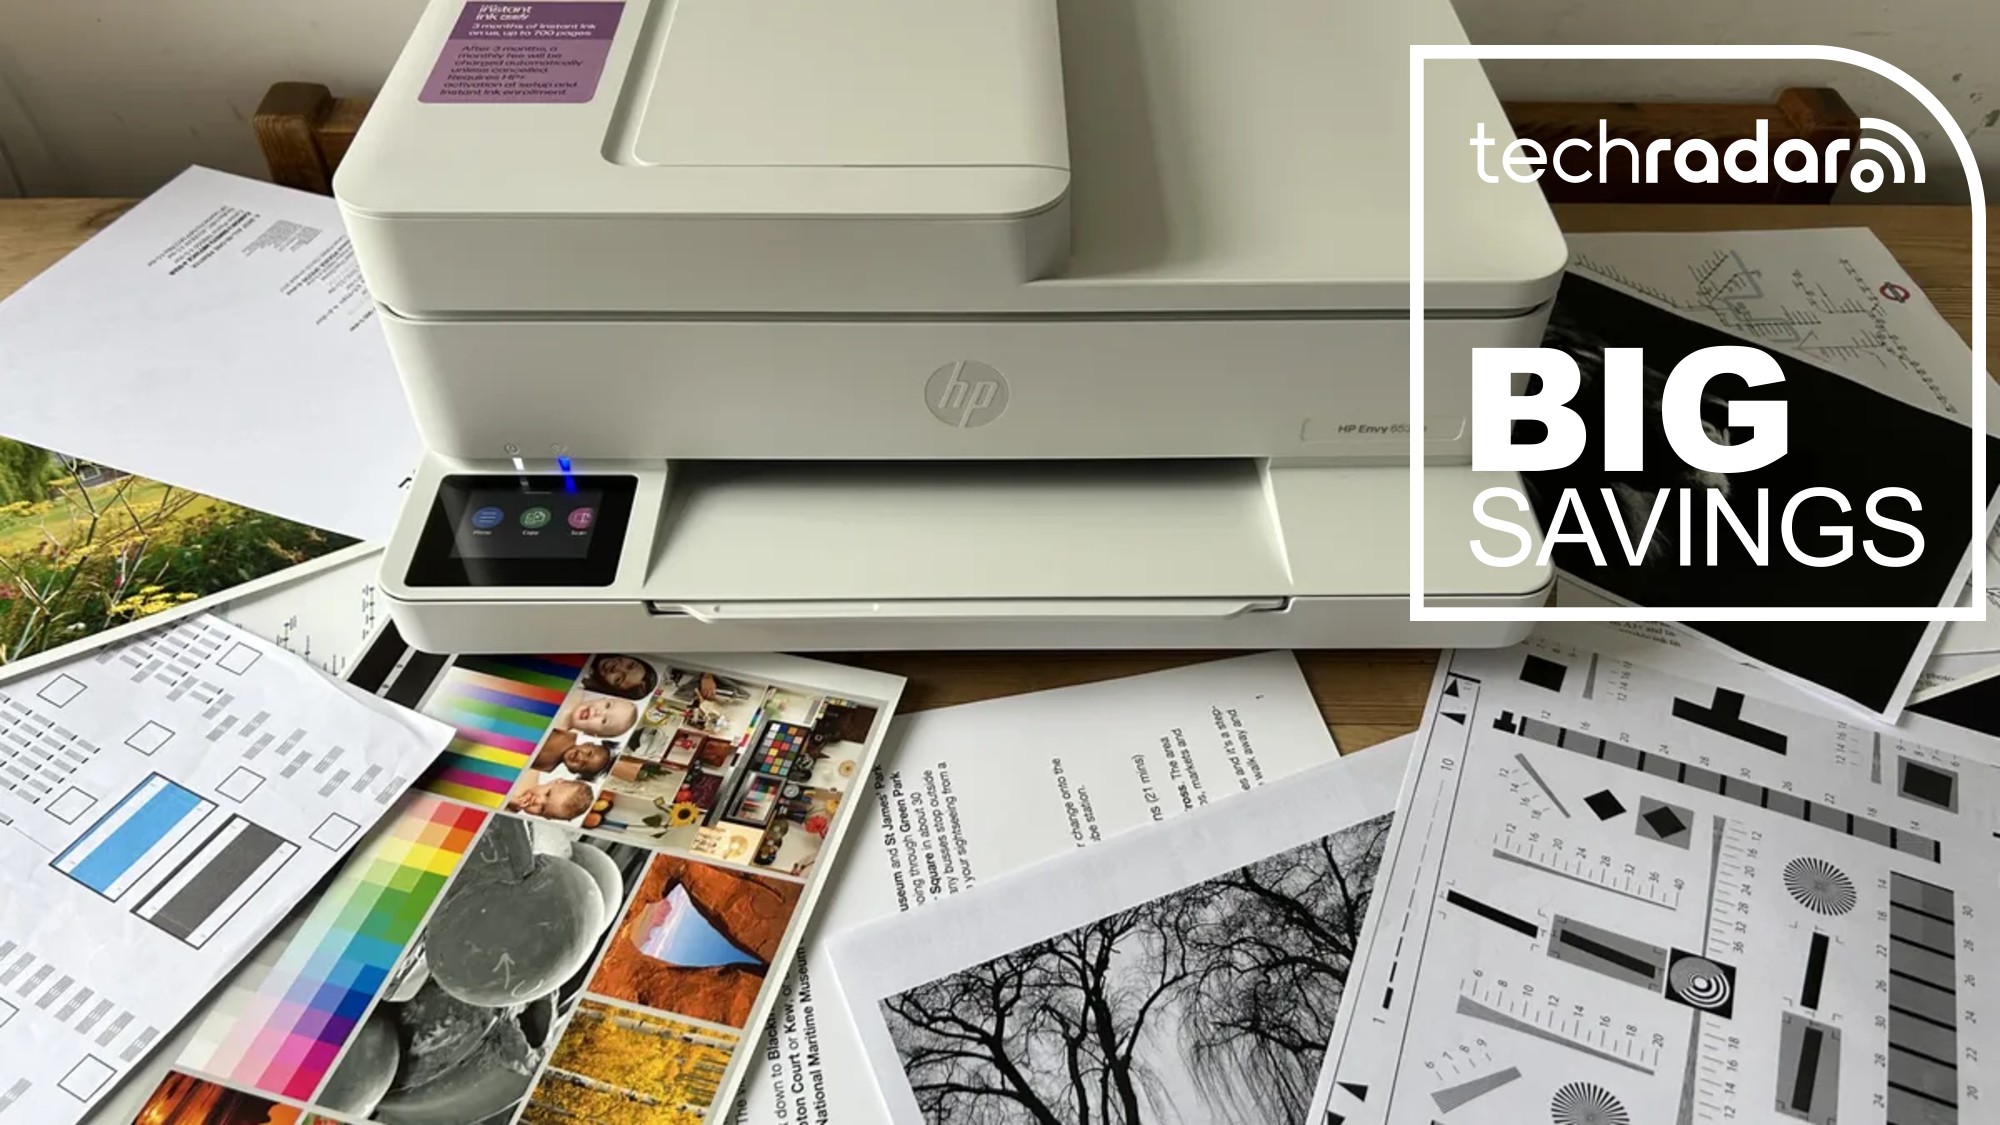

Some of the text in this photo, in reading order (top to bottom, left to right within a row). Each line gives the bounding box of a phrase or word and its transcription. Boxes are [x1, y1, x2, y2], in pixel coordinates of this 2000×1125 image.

[1338, 424, 1356, 434] HP
[1358, 424, 1388, 435] Envy
[1617, 692, 1627, 701] 12
[1541, 709, 1551, 719] 12
[1211, 704, 1245, 776] and it's a step-
[1620, 731, 1630, 743] 20
[1227, 708, 1264, 781] walk away and
[1659, 744, 1669, 755] 24
[1171, 727, 1202, 789] markets and
[1440, 757, 1454, 771] 10
[1835, 755, 1846, 764] 12
[872, 763, 885, 790] Park
[1131, 754, 1159, 804] (21 mins)
[1160, 736, 1193, 811] ross. The area
[1499, 767, 1510, 778] 12
[923, 769, 939, 808] outside
[1510, 782, 1520, 793] 14
[1052, 757, 1084, 841] change onto the
[1077, 784, 1096, 823] station.
[1520, 796, 1530, 807] 16
[1824, 793, 1835, 805] 22
[932, 809, 946, 833] stop
[1531, 809, 1542, 820] 18
[890, 771, 920, 877] through Green Park
[938, 761, 976, 886] your sightseeing from a
[1505, 823, 1517, 833] 12
[884, 833, 896, 846] St
[1528, 832, 1540, 842] 16
[1751, 831, 1762, 841] 12
[910, 791, 942, 895] Square in about 30
[1552, 838, 1564, 850] 20
[886, 848, 900, 869] and
[937, 834, 954, 874] busses
[1576, 847, 1587, 859] 24
[1600, 855, 1611, 867] 28
[1624, 863, 1635, 875] 32
[1744, 865, 1755, 878] 20
[1648, 871, 1659, 883] 36
[1674, 878, 1685, 891] 40
[1741, 883, 1752, 896] 24
[893, 871, 909, 912] useum
[1734, 921, 1747, 934] 32
[1876, 944, 1887, 957] 22
[797, 946, 812, 1003] Museum
[1473, 969, 1483, 978] 6
[1499, 979, 1508, 988] 8
[1522, 984, 1534, 997] 10
[1548, 994, 1560, 1008] 12
[783, 998, 797, 1034] Kew,
[1573, 1004, 1585, 1018] 14
[1965, 1010, 1976, 1024] 24
[1599, 1015, 1611, 1028] 16
[803, 1005, 821, 1067] Maritime
[1625, 1024, 1638, 1037] 18
[788, 1037, 799, 1051] or
[1476, 1038, 1487, 1047] 9
[1652, 1033, 1664, 1048] 20
[1728, 1036, 1740, 1049] 18
[1459, 1044, 1470, 1053] 8
[1966, 1046, 1978, 1061] 22
[1442, 1051, 1453, 1061] 7
[771, 1063, 783, 1078] to
[1424, 1061, 1435, 1069] 6
[1726, 1059, 1738, 1072] 16
[788, 1052, 805, 1094] Court
[1724, 1081, 1736, 1094] 14
[1966, 1085, 1979, 1100] 20
[773, 1080, 788, 1119] down
[1873, 1093, 1884, 1108] 24
[1723, 1105, 1736, 1119] 12
